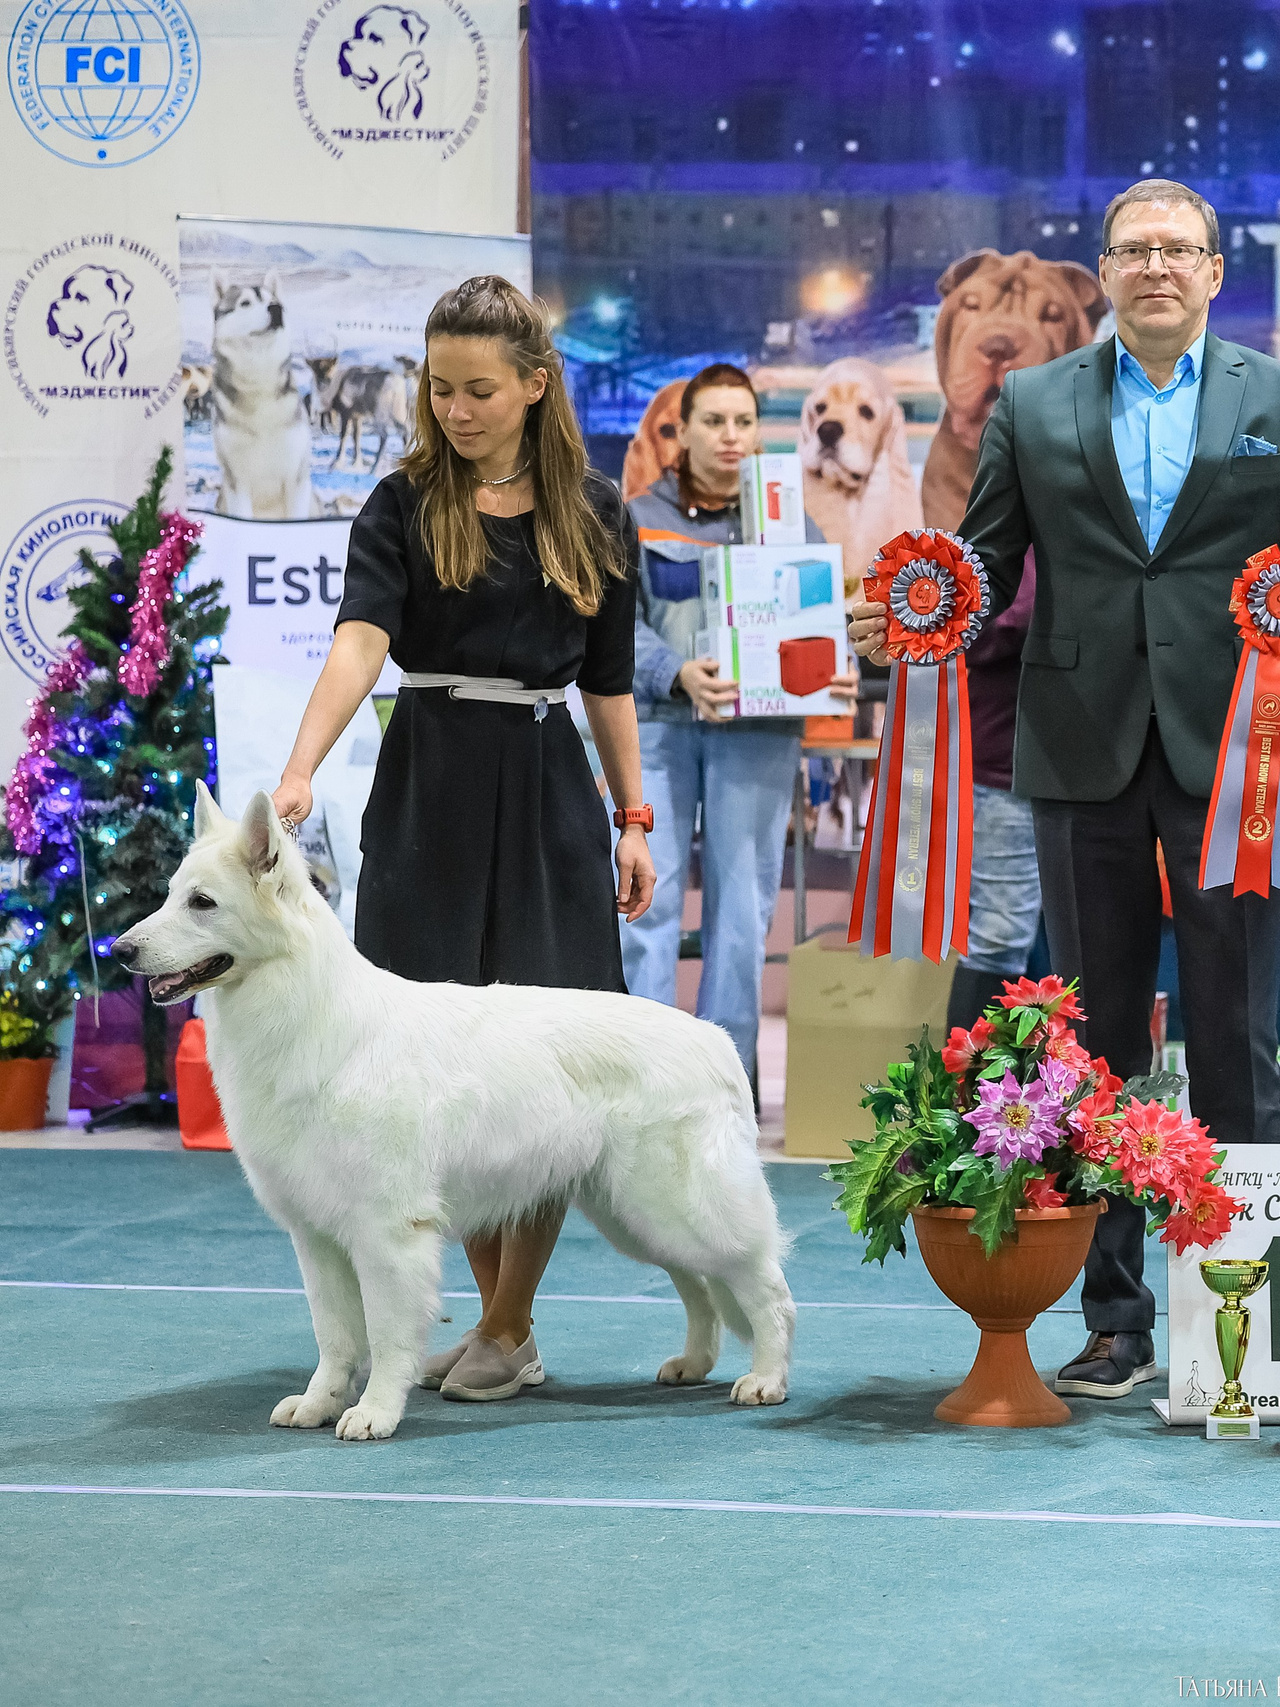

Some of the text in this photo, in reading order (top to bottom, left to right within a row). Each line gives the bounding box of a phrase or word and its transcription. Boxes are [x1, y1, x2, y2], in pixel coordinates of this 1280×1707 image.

[66, 46, 141, 84] FCI
[148, 0, 193, 138] NTERNATIONALE
[5, 565, 55, 675] ОССИЙСКАЯ
[1262, 737, 1272, 754] BEST
[1260, 755, 1271, 763] IN
[912, 768, 924, 787] BEST
[1257, 763, 1269, 783] SHOW
[1255, 783, 1267, 814] VETERAN
[910, 798, 922, 822] SHOW
[1252, 821, 1263, 835] 2
[908, 823, 921, 859] VETERAN
[906, 872, 917, 885] 1
[1222, 1172, 1264, 1191] НГКЦ
